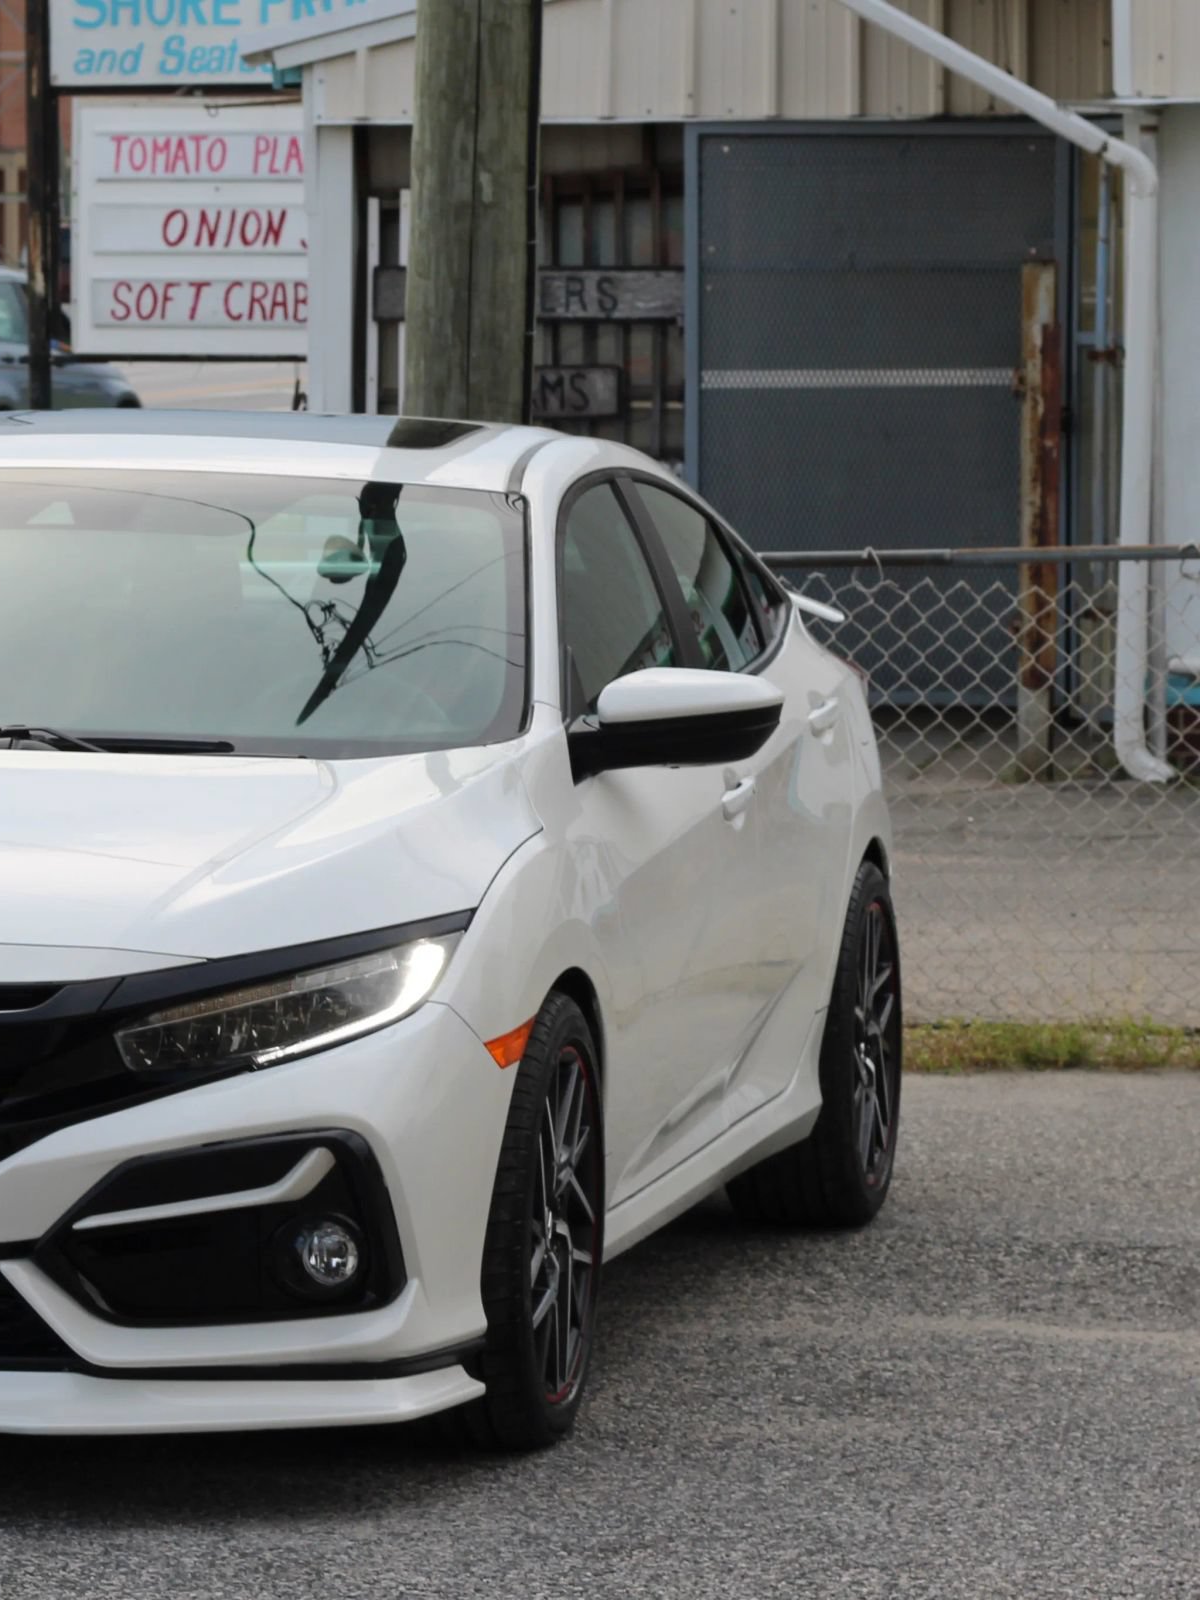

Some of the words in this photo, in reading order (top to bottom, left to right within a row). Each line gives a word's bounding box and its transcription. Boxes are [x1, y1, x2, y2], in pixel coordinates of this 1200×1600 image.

[73, 41, 144, 75] and
[158, 34, 272, 76] Seaf
[110, 135, 228, 174] TOMATO
[161, 208, 287, 248] ONION
[110, 280, 211, 321] SOFT
